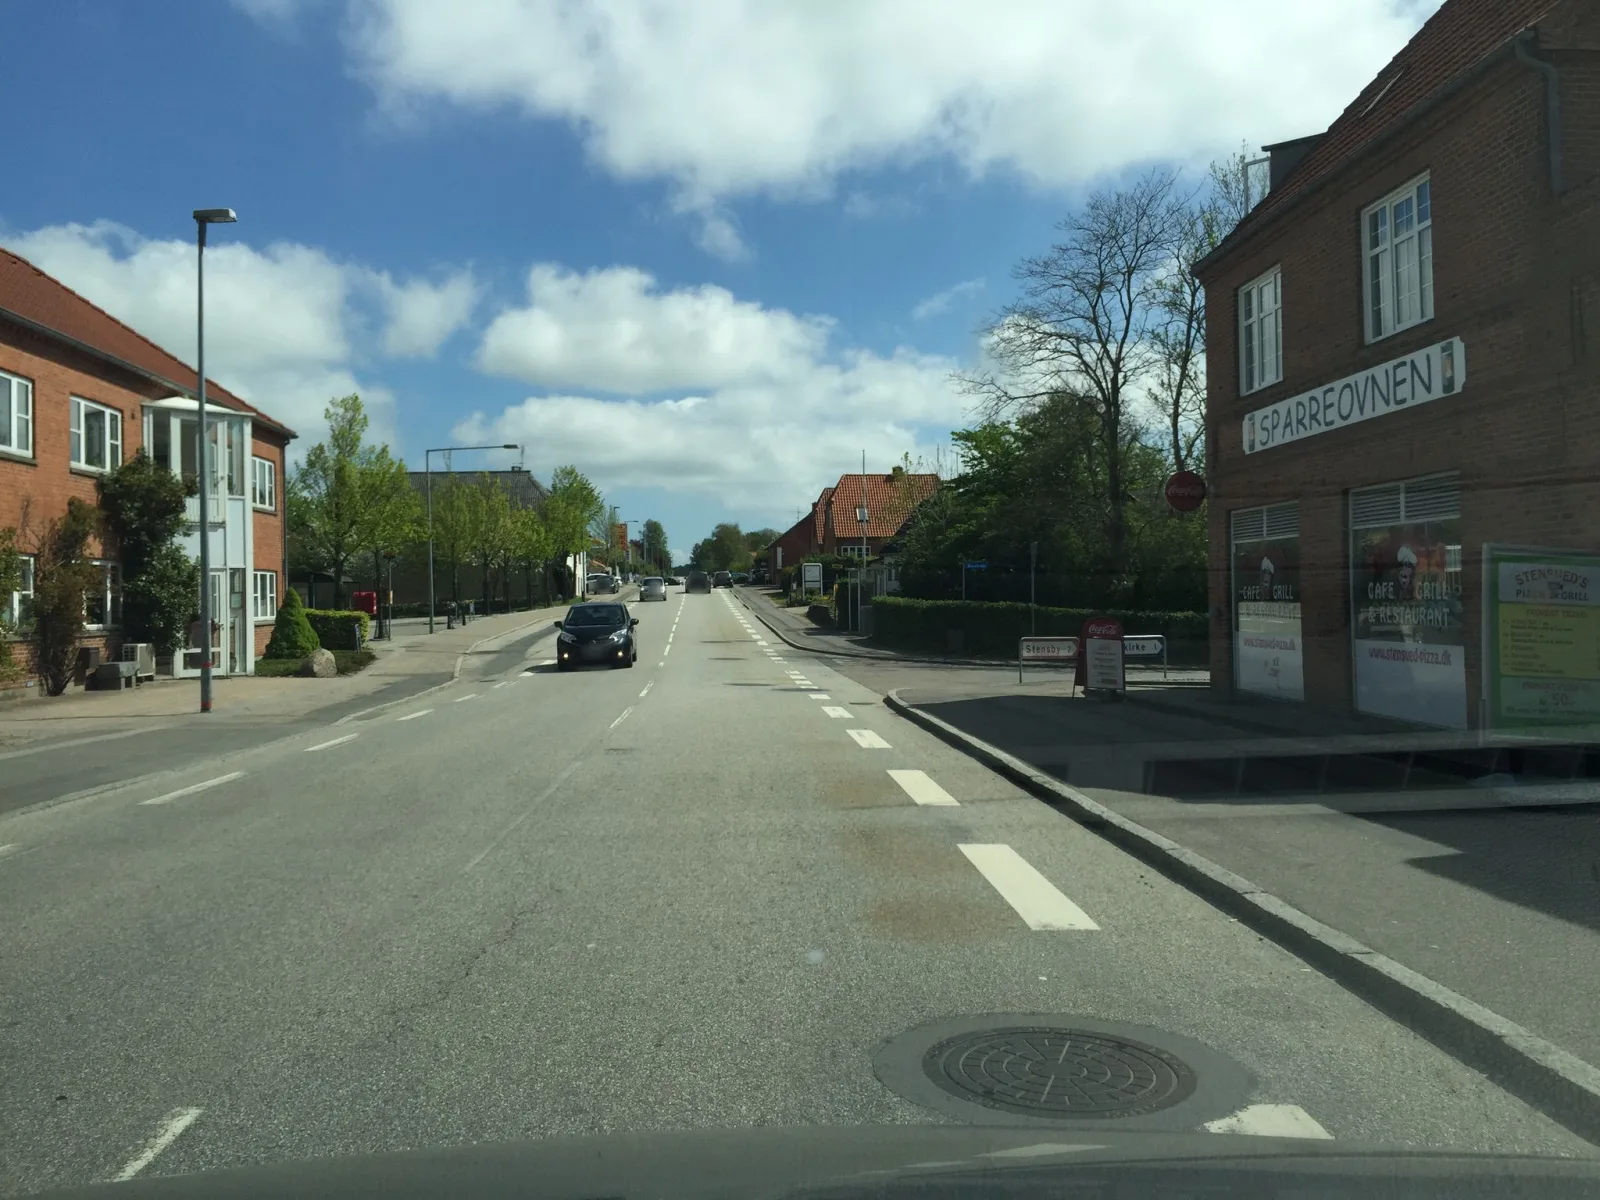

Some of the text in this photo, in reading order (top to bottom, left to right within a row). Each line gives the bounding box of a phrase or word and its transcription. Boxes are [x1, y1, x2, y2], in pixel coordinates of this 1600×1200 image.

[1259, 352, 1433, 447] SPARREOVNEN
[1243, 585, 1294, 600] CAFE GRILL
[1368, 581, 1449, 600] CAFE GRILL
[1561, 590, 1590, 602] GRILL
[1379, 606, 1450, 627] RESTAURANT
[1025, 644, 1061, 656] Stensby
